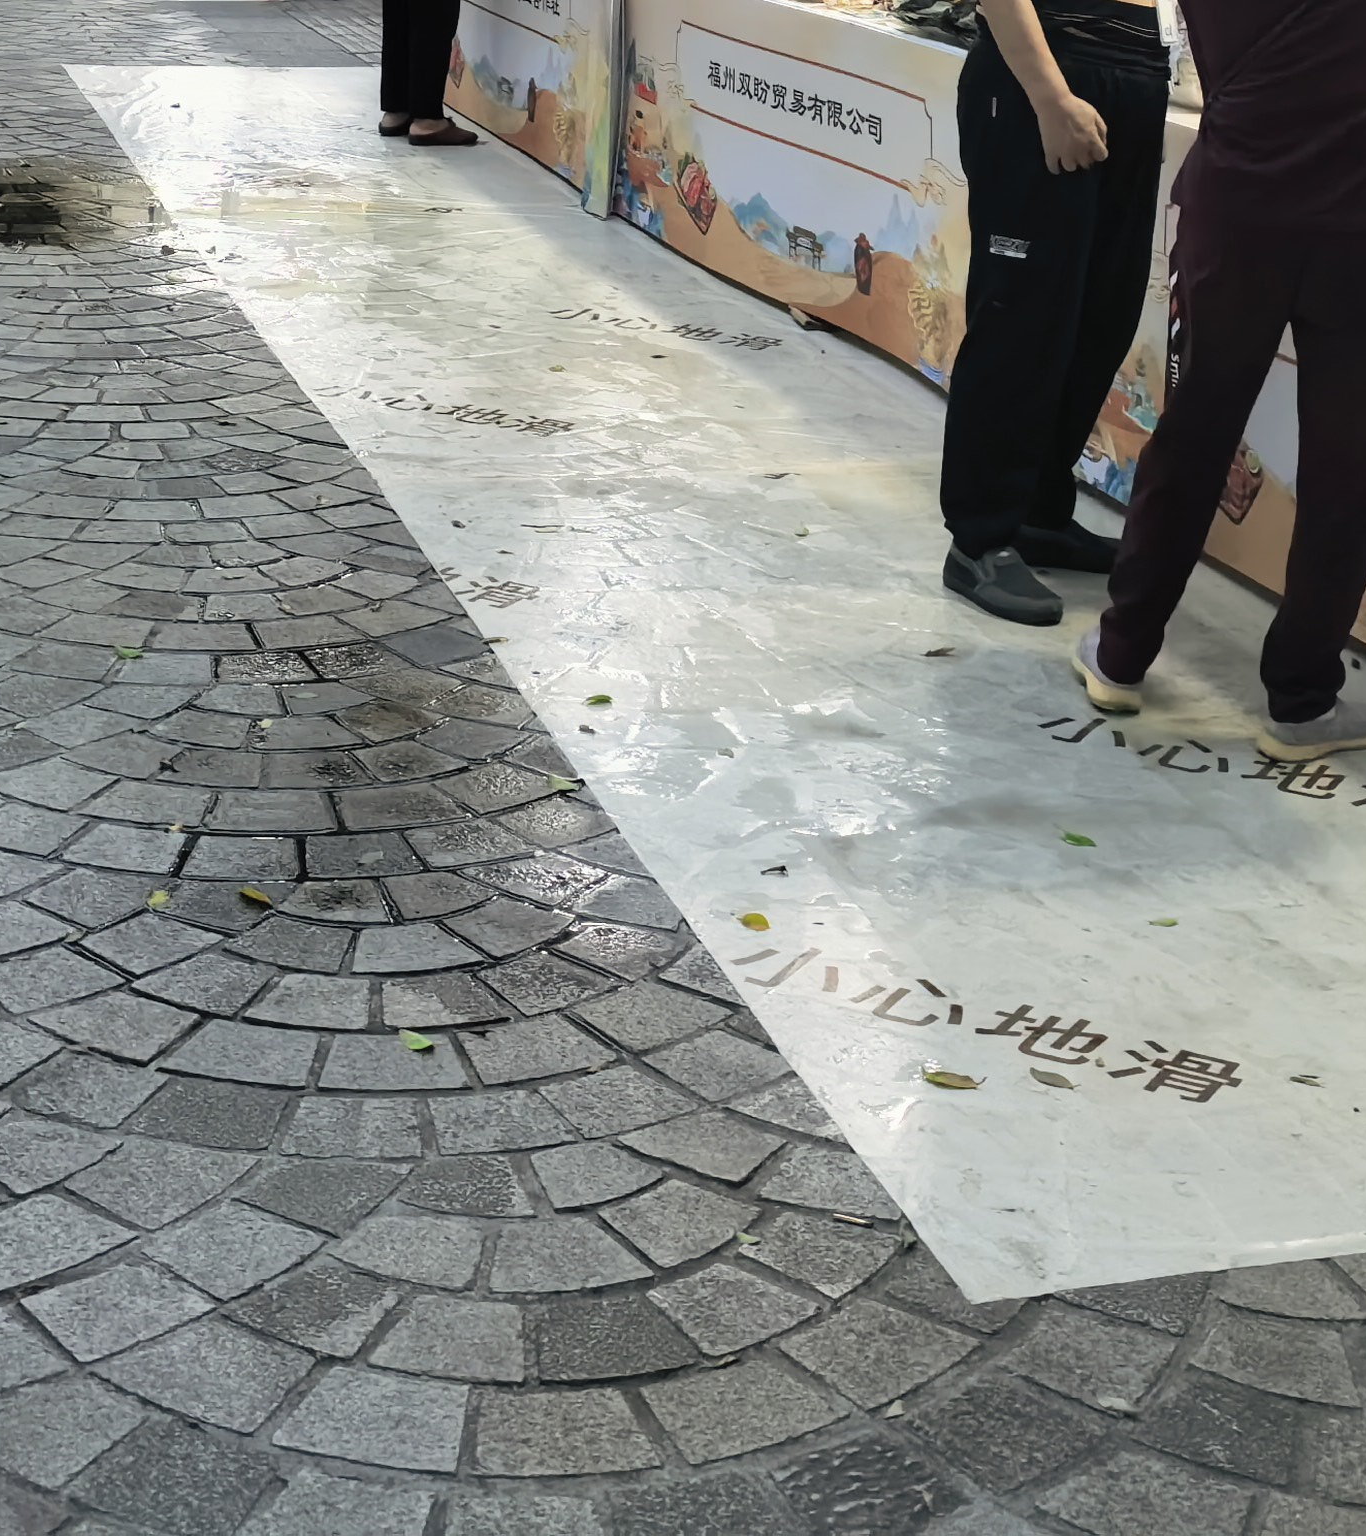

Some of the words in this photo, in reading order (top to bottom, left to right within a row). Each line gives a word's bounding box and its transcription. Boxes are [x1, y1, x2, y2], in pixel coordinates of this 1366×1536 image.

[707, 60, 884, 146] 福州双盼贸易有限公司
[547, 308, 784, 351] 小心地滑
[731, 947, 1244, 1104] 小心地滑
